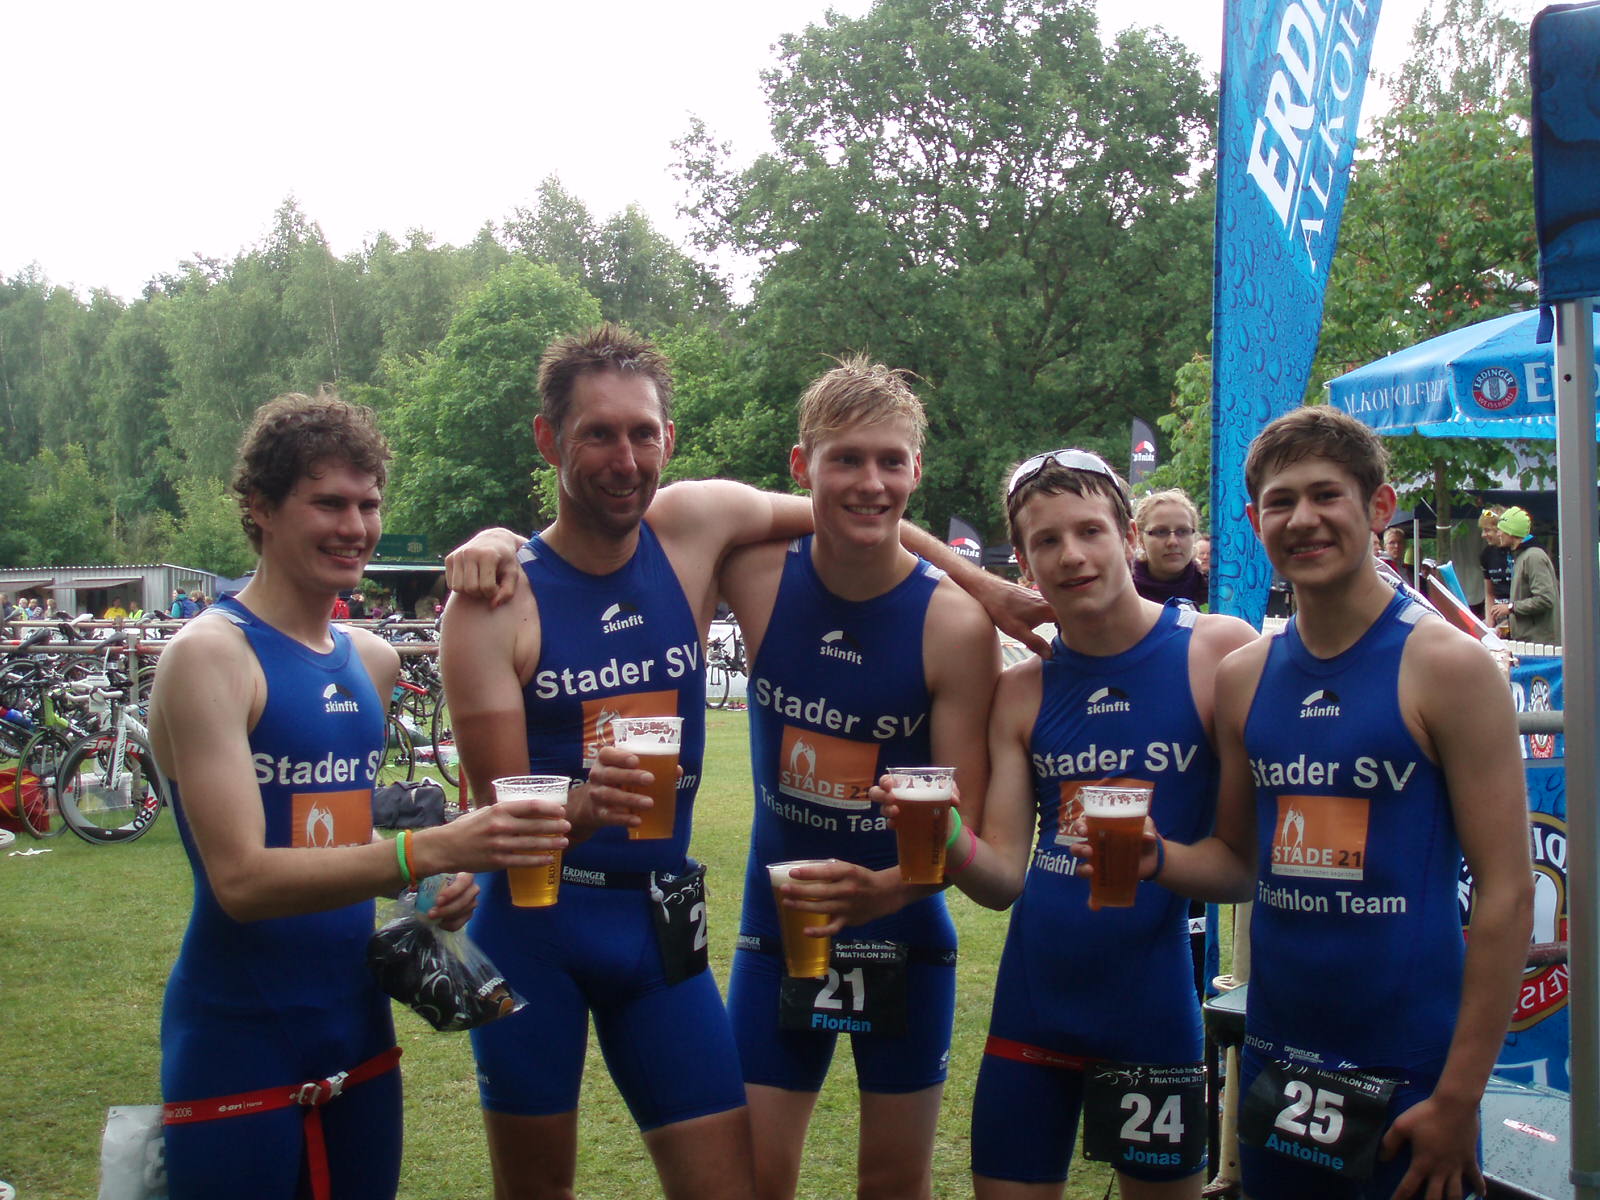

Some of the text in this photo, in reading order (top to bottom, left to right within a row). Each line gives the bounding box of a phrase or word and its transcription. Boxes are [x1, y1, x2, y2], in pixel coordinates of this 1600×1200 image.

[1474, 368, 1514, 388] ERDINGER
[602, 614, 644, 634] skinfit
[819, 644, 863, 665] skinfit
[535, 641, 698, 699] Stader SV
[325, 701, 359, 713] skinfit
[755, 678, 926, 740] Stader SV
[1087, 701, 1131, 715] skinfit
[1299, 705, 1340, 719] skinfit
[251, 752, 360, 785] Stader
[1032, 741, 1199, 778] Stader SV
[1249, 753, 1417, 791] Stader SV
[780, 771, 845, 798] STADE
[759, 784, 838, 833] Triathlon
[847, 815, 888, 833] Tea
[1273, 845, 1362, 868] STADE 21
[562, 865, 606, 882] ERDINGER
[1258, 880, 1406, 913] Triathlon Team
[835, 951, 897, 960] TRIATHLON 2012
[814, 967, 865, 1012] 21
[810, 1012, 872, 1033] Florian
[1148, 1076, 1191, 1085] TRIATHLON
[1316, 1069, 1381, 1095] TRIATHLON 2012
[1119, 1092, 1185, 1143] 24
[1273, 1080, 1345, 1145] 25
[1123, 1145, 1181, 1166] Jonas
[1264, 1132, 1345, 1171] Antoine
